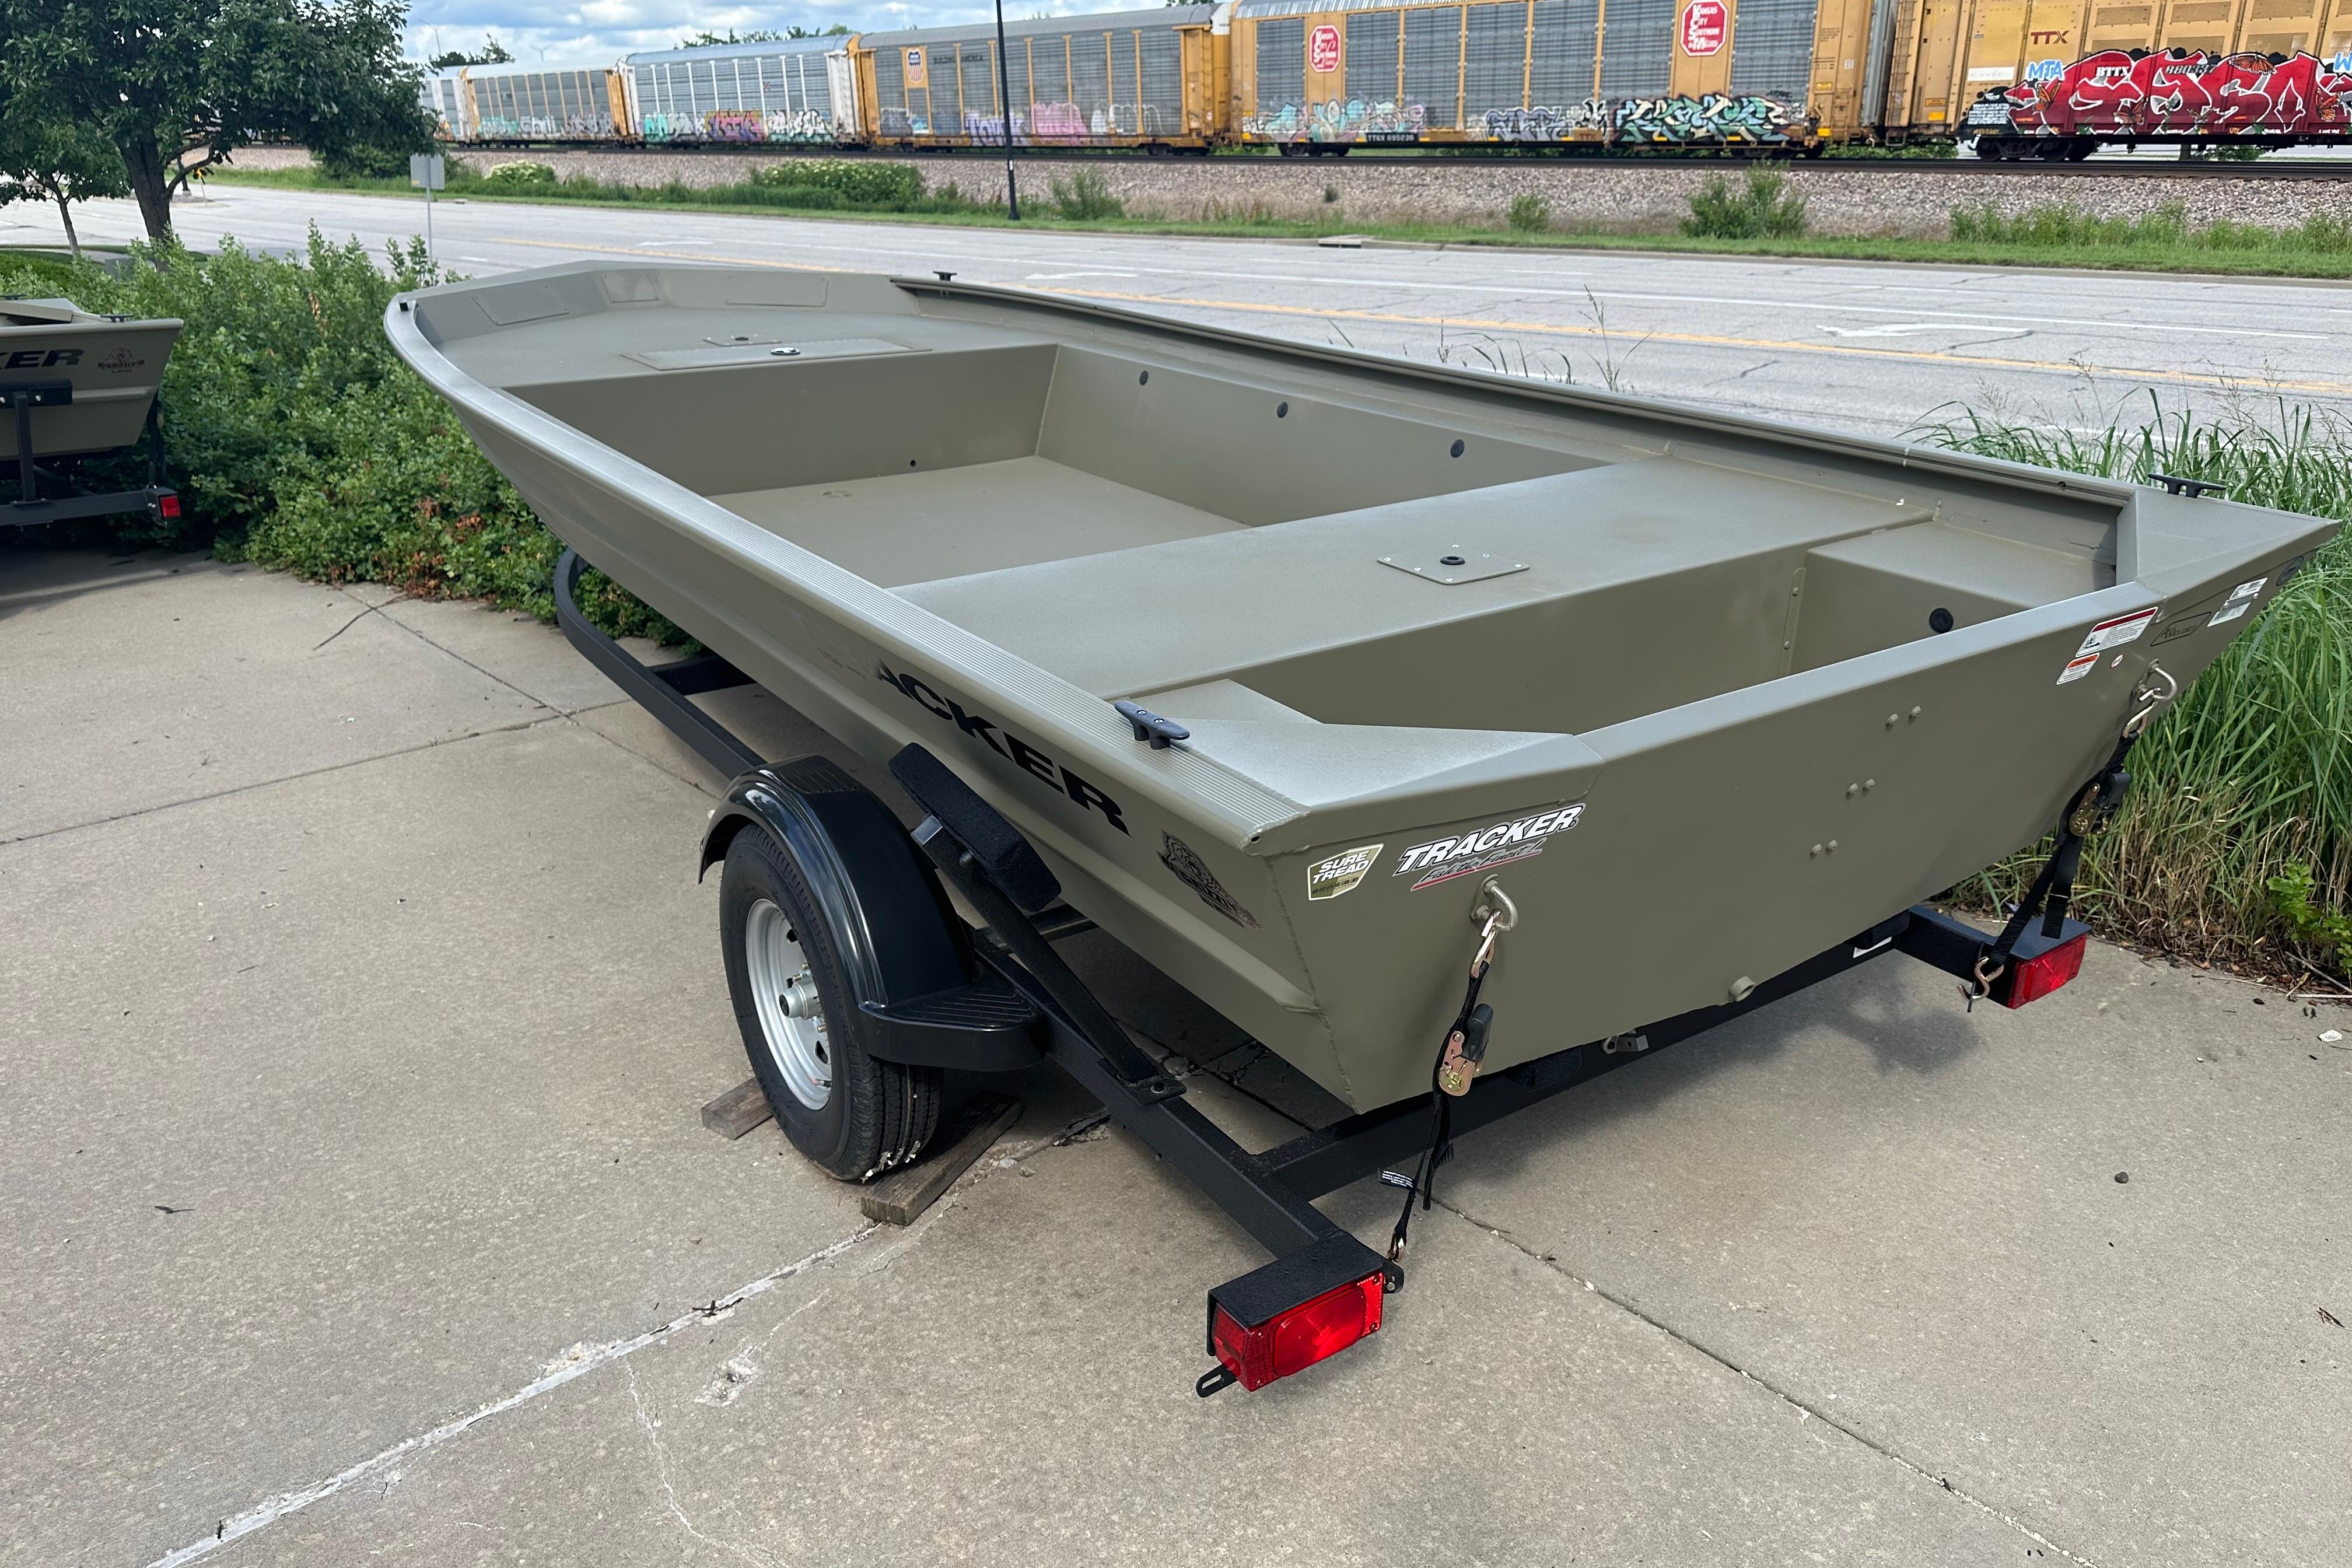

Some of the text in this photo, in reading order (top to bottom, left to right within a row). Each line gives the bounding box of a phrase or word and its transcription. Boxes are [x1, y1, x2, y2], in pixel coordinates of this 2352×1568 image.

[2031, 30, 2069, 45] TTX
[2028, 60, 2062, 79] MTA
[2096, 64, 2217, 77] BTTX 880337
[1395, 805, 1584, 874] TRACKER
[1312, 860, 1370, 884] TREAD
[1318, 850, 1370, 873] SURE
